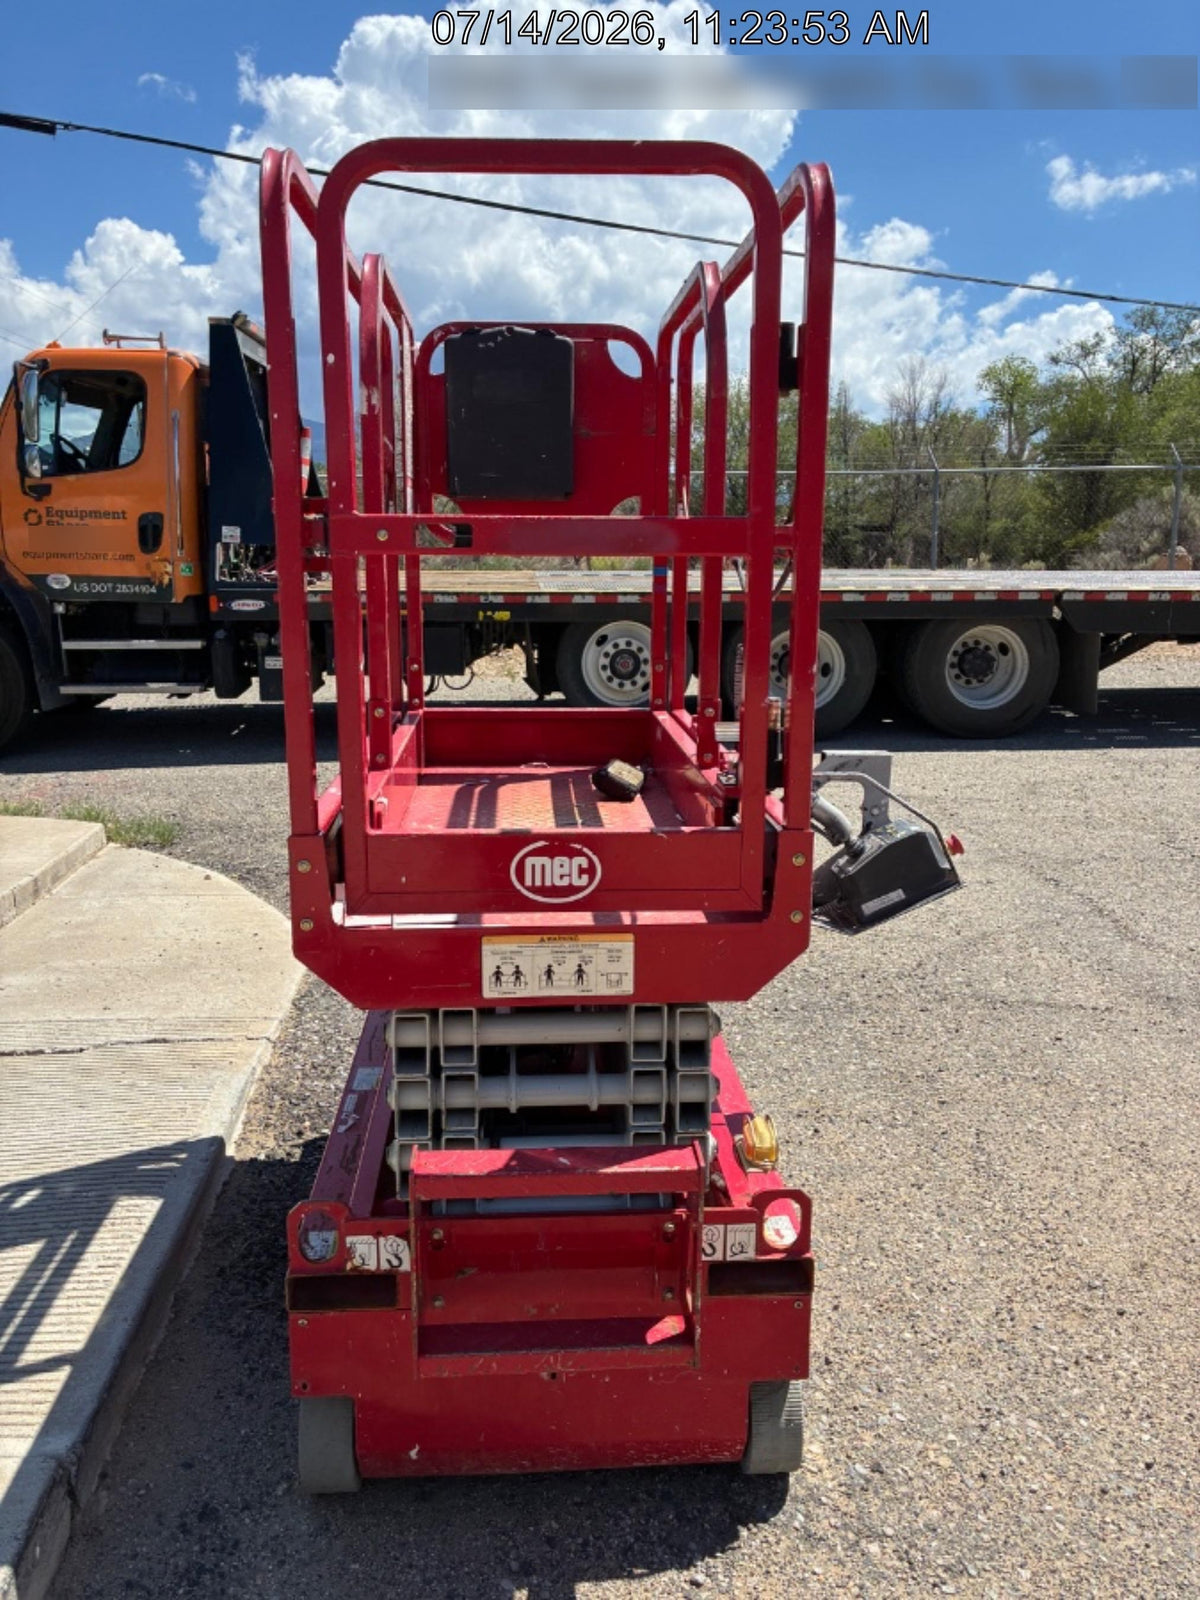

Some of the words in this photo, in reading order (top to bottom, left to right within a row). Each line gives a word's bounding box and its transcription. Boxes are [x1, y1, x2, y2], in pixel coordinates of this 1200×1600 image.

[45, 506, 128, 521] Equipment
[73, 582, 89, 593] US
[90, 582, 114, 593] DOT
